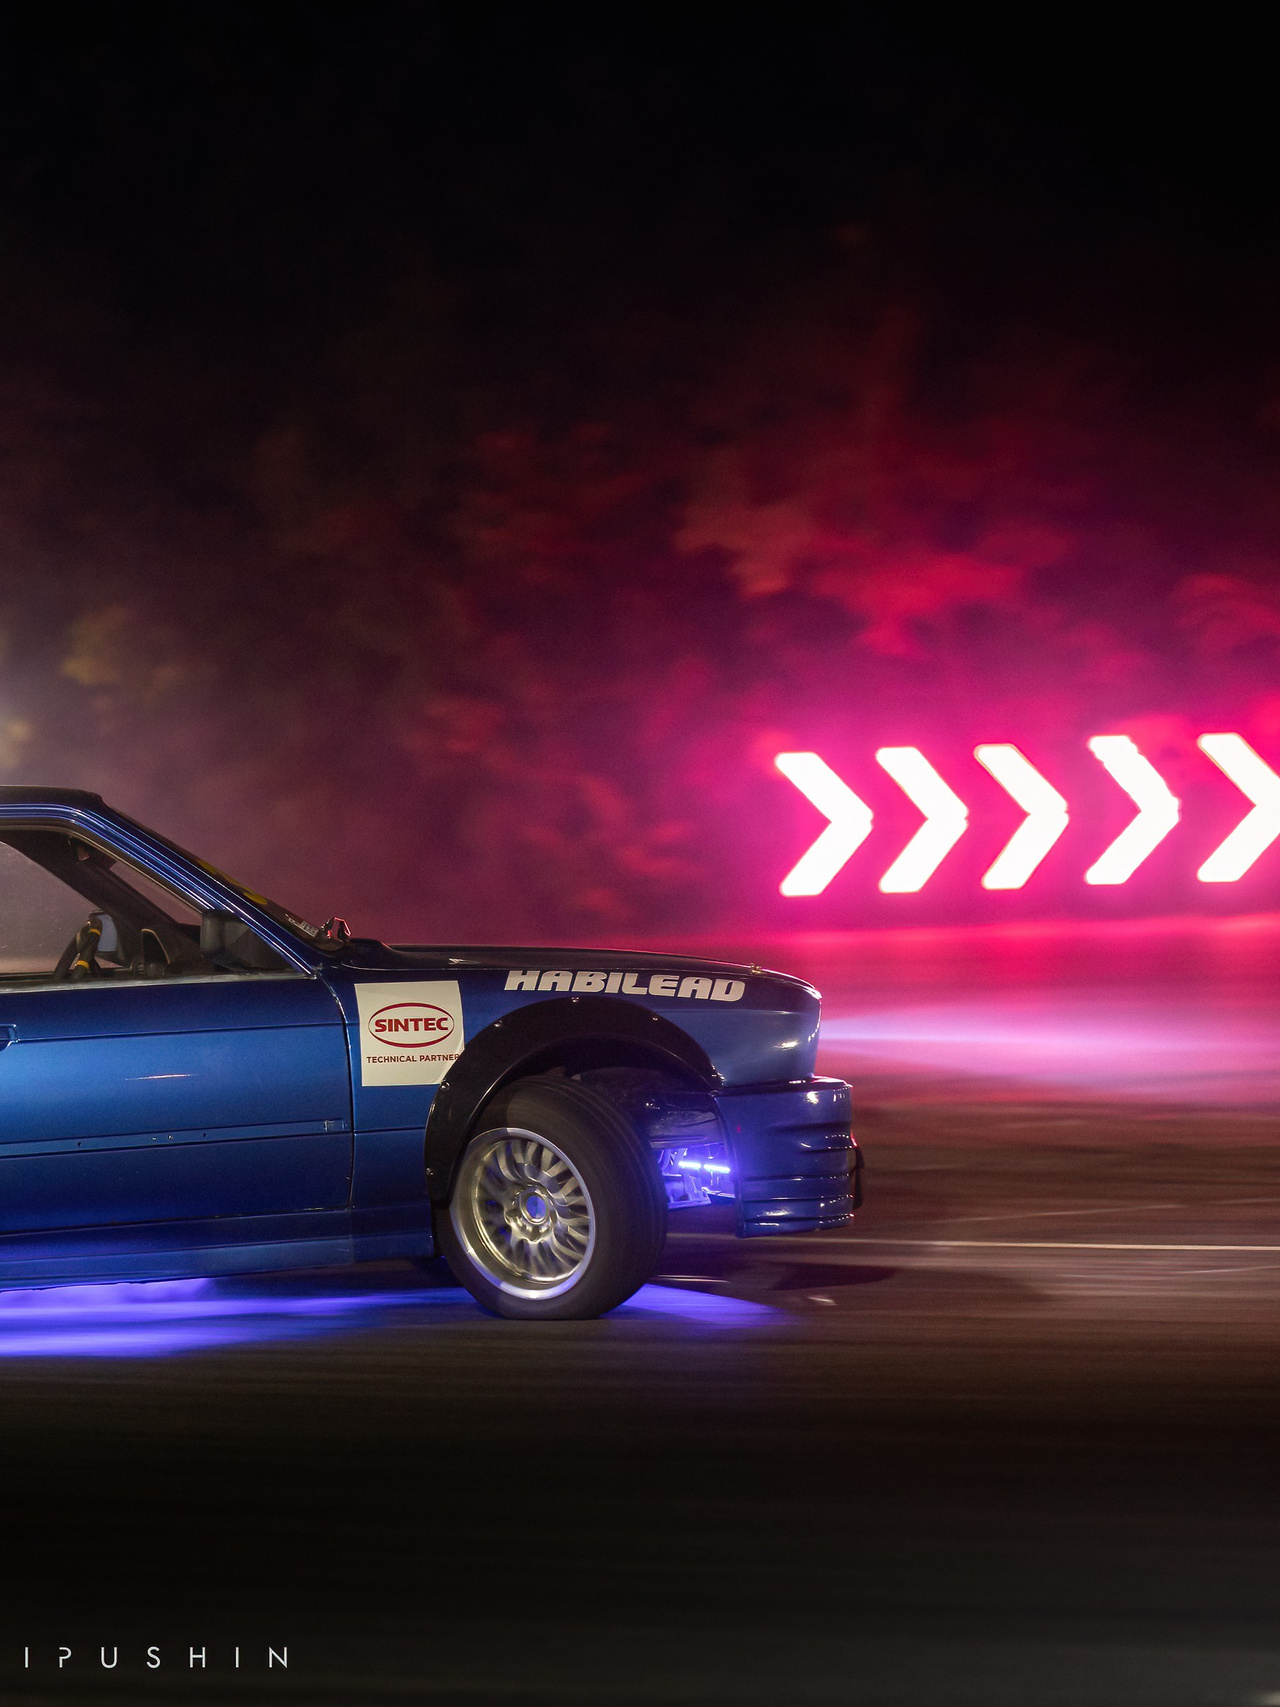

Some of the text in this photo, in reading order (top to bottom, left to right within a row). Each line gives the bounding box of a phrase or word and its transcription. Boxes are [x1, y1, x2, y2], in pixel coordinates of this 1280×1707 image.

[504, 970, 746, 1002] HABILEAD
[374, 1017, 449, 1033] SINTEC
[366, 1055, 417, 1064] TECHNICAL
